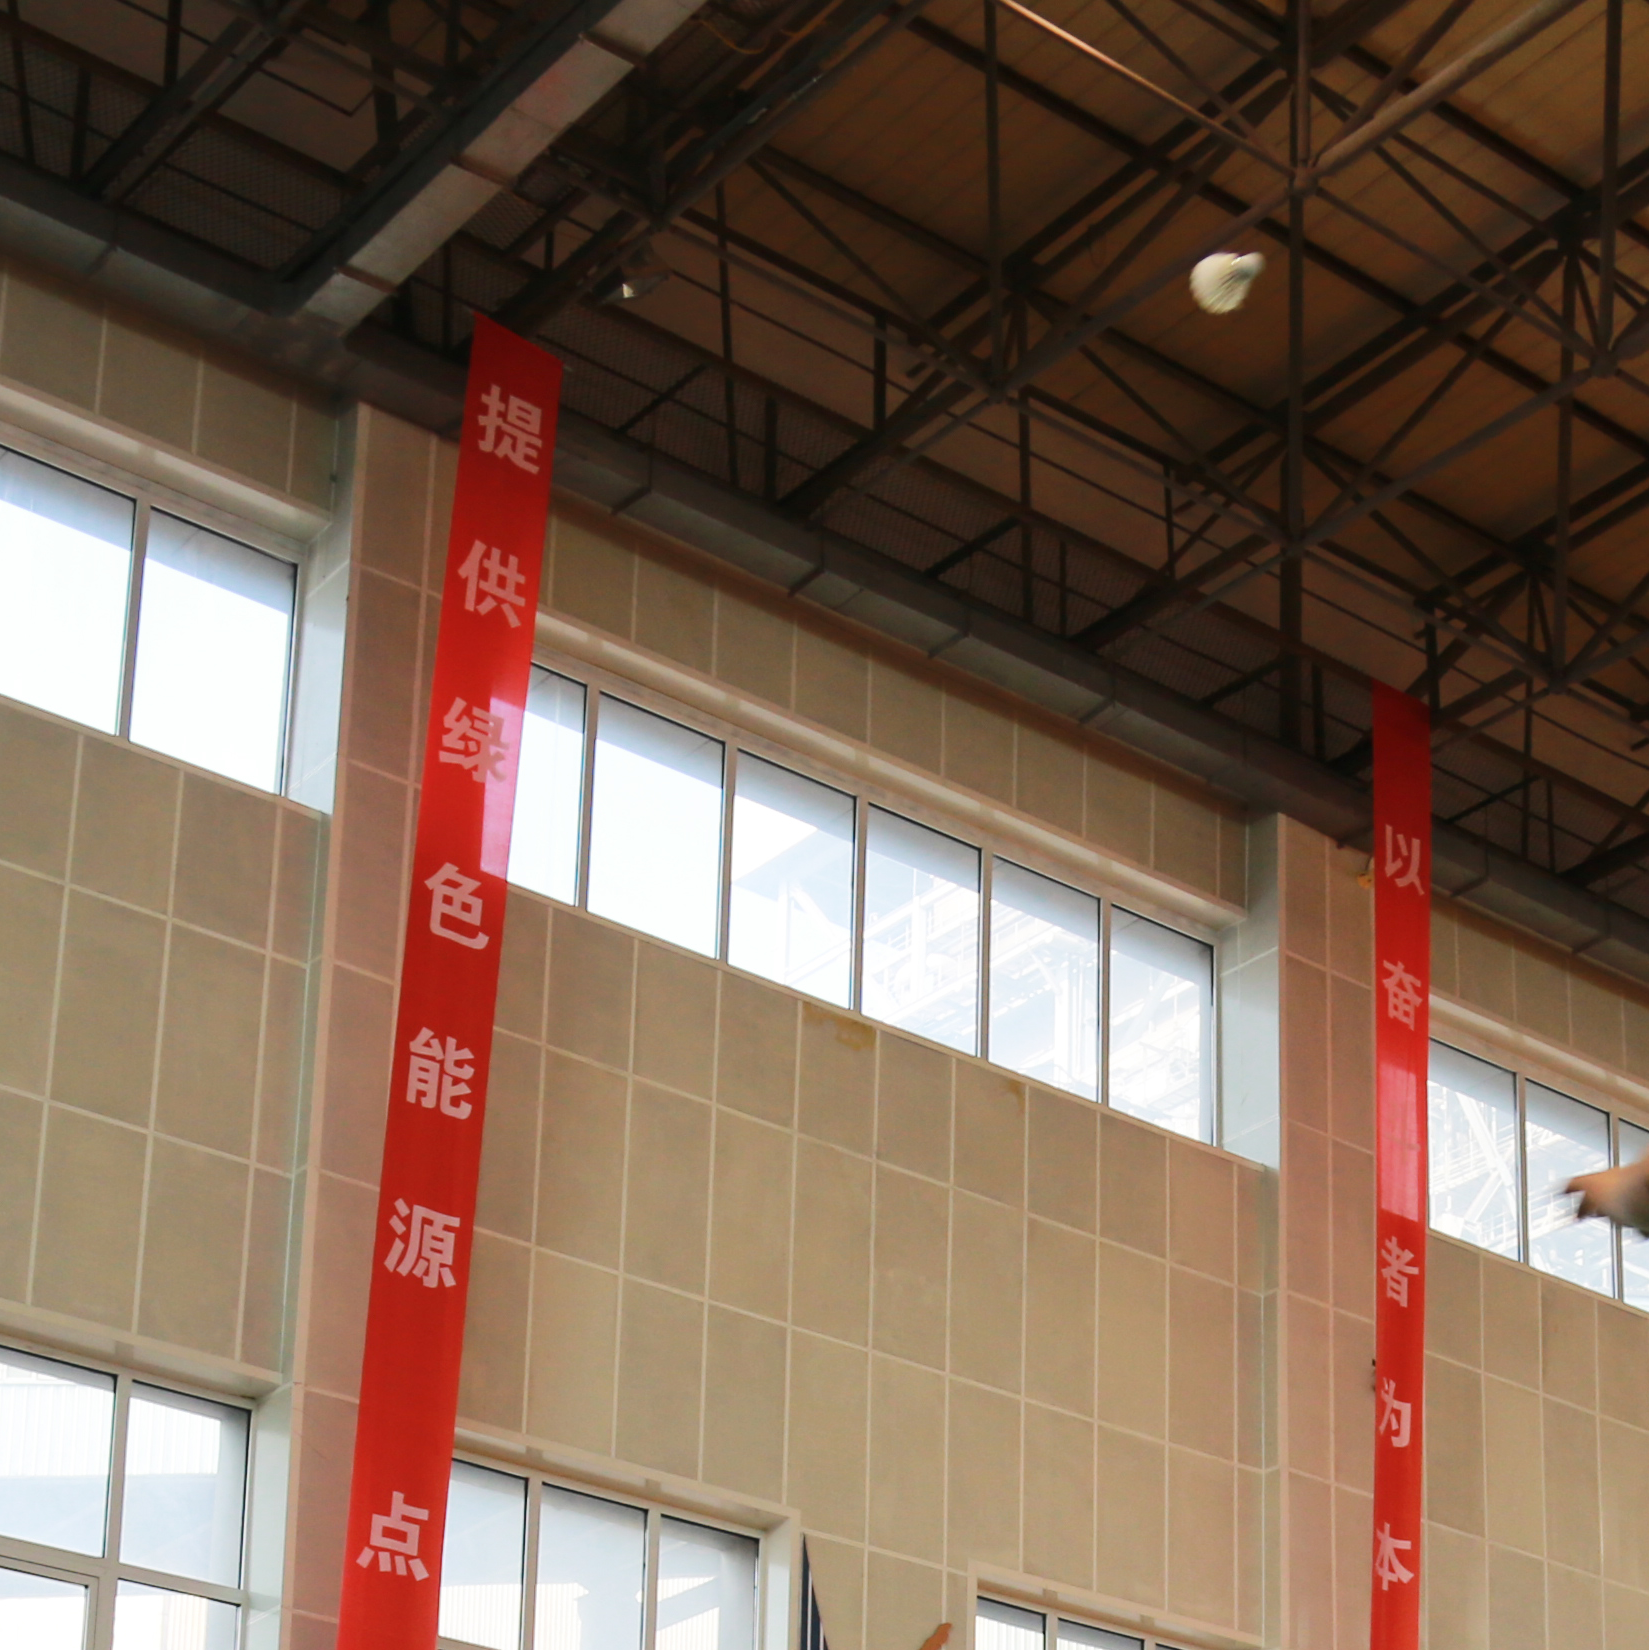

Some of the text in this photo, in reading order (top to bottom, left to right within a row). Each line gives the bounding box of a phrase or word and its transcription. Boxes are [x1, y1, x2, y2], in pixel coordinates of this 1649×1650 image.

[384, 382, 544, 1290] 提供绿色能源
